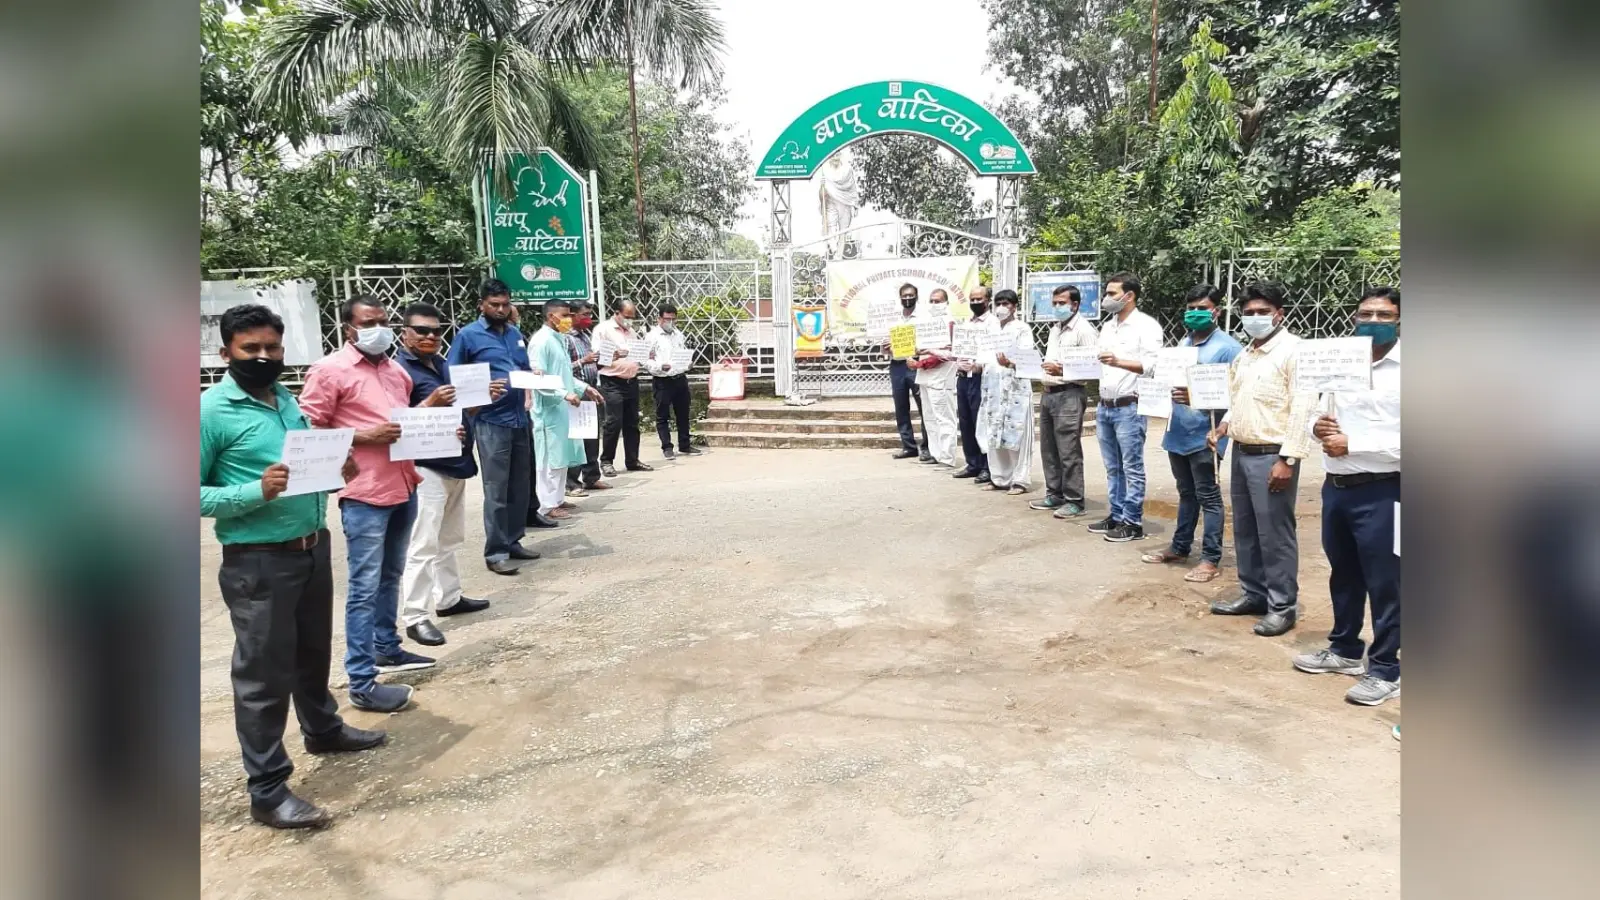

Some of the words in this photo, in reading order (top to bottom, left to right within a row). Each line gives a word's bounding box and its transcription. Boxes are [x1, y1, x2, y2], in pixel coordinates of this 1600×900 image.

[812, 103, 872, 144] बापू
[877, 88, 983, 142] वाटिका
[494, 211, 531, 234] बापू
[514, 228, 581, 251] वाटिका
[840, 280, 868, 309] NATIONAL
[866, 269, 897, 286] PRIVATE
[897, 268, 926, 279] SCHOOL
